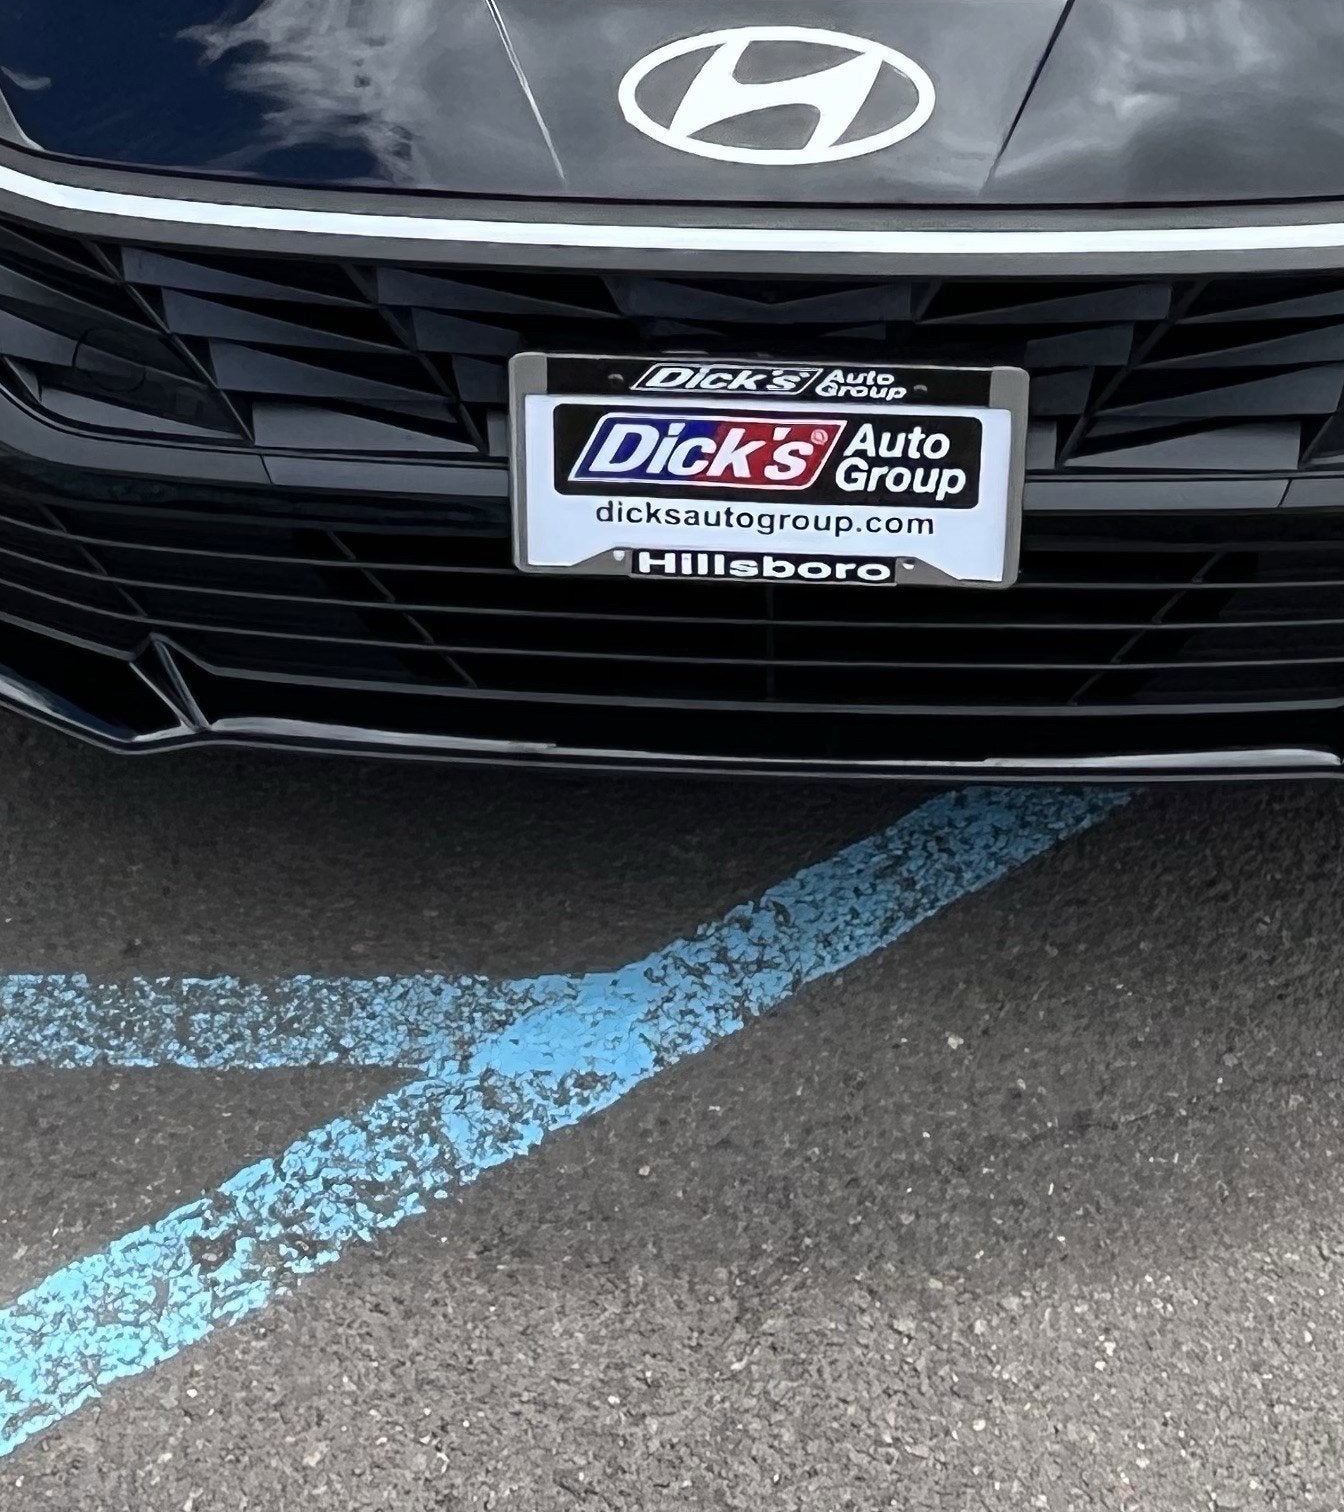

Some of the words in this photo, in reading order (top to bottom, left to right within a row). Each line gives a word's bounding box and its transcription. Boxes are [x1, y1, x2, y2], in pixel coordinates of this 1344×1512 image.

[645, 367, 803, 392] Dick's
[815, 382, 907, 402] Group
[823, 369, 895, 385] Auto
[588, 422, 814, 481] Dick's
[843, 423, 951, 460] Auto
[835, 458, 967, 501] Group
[596, 500, 934, 537] dicksautogroup.com
[638, 551, 891, 582] Hillsboro
